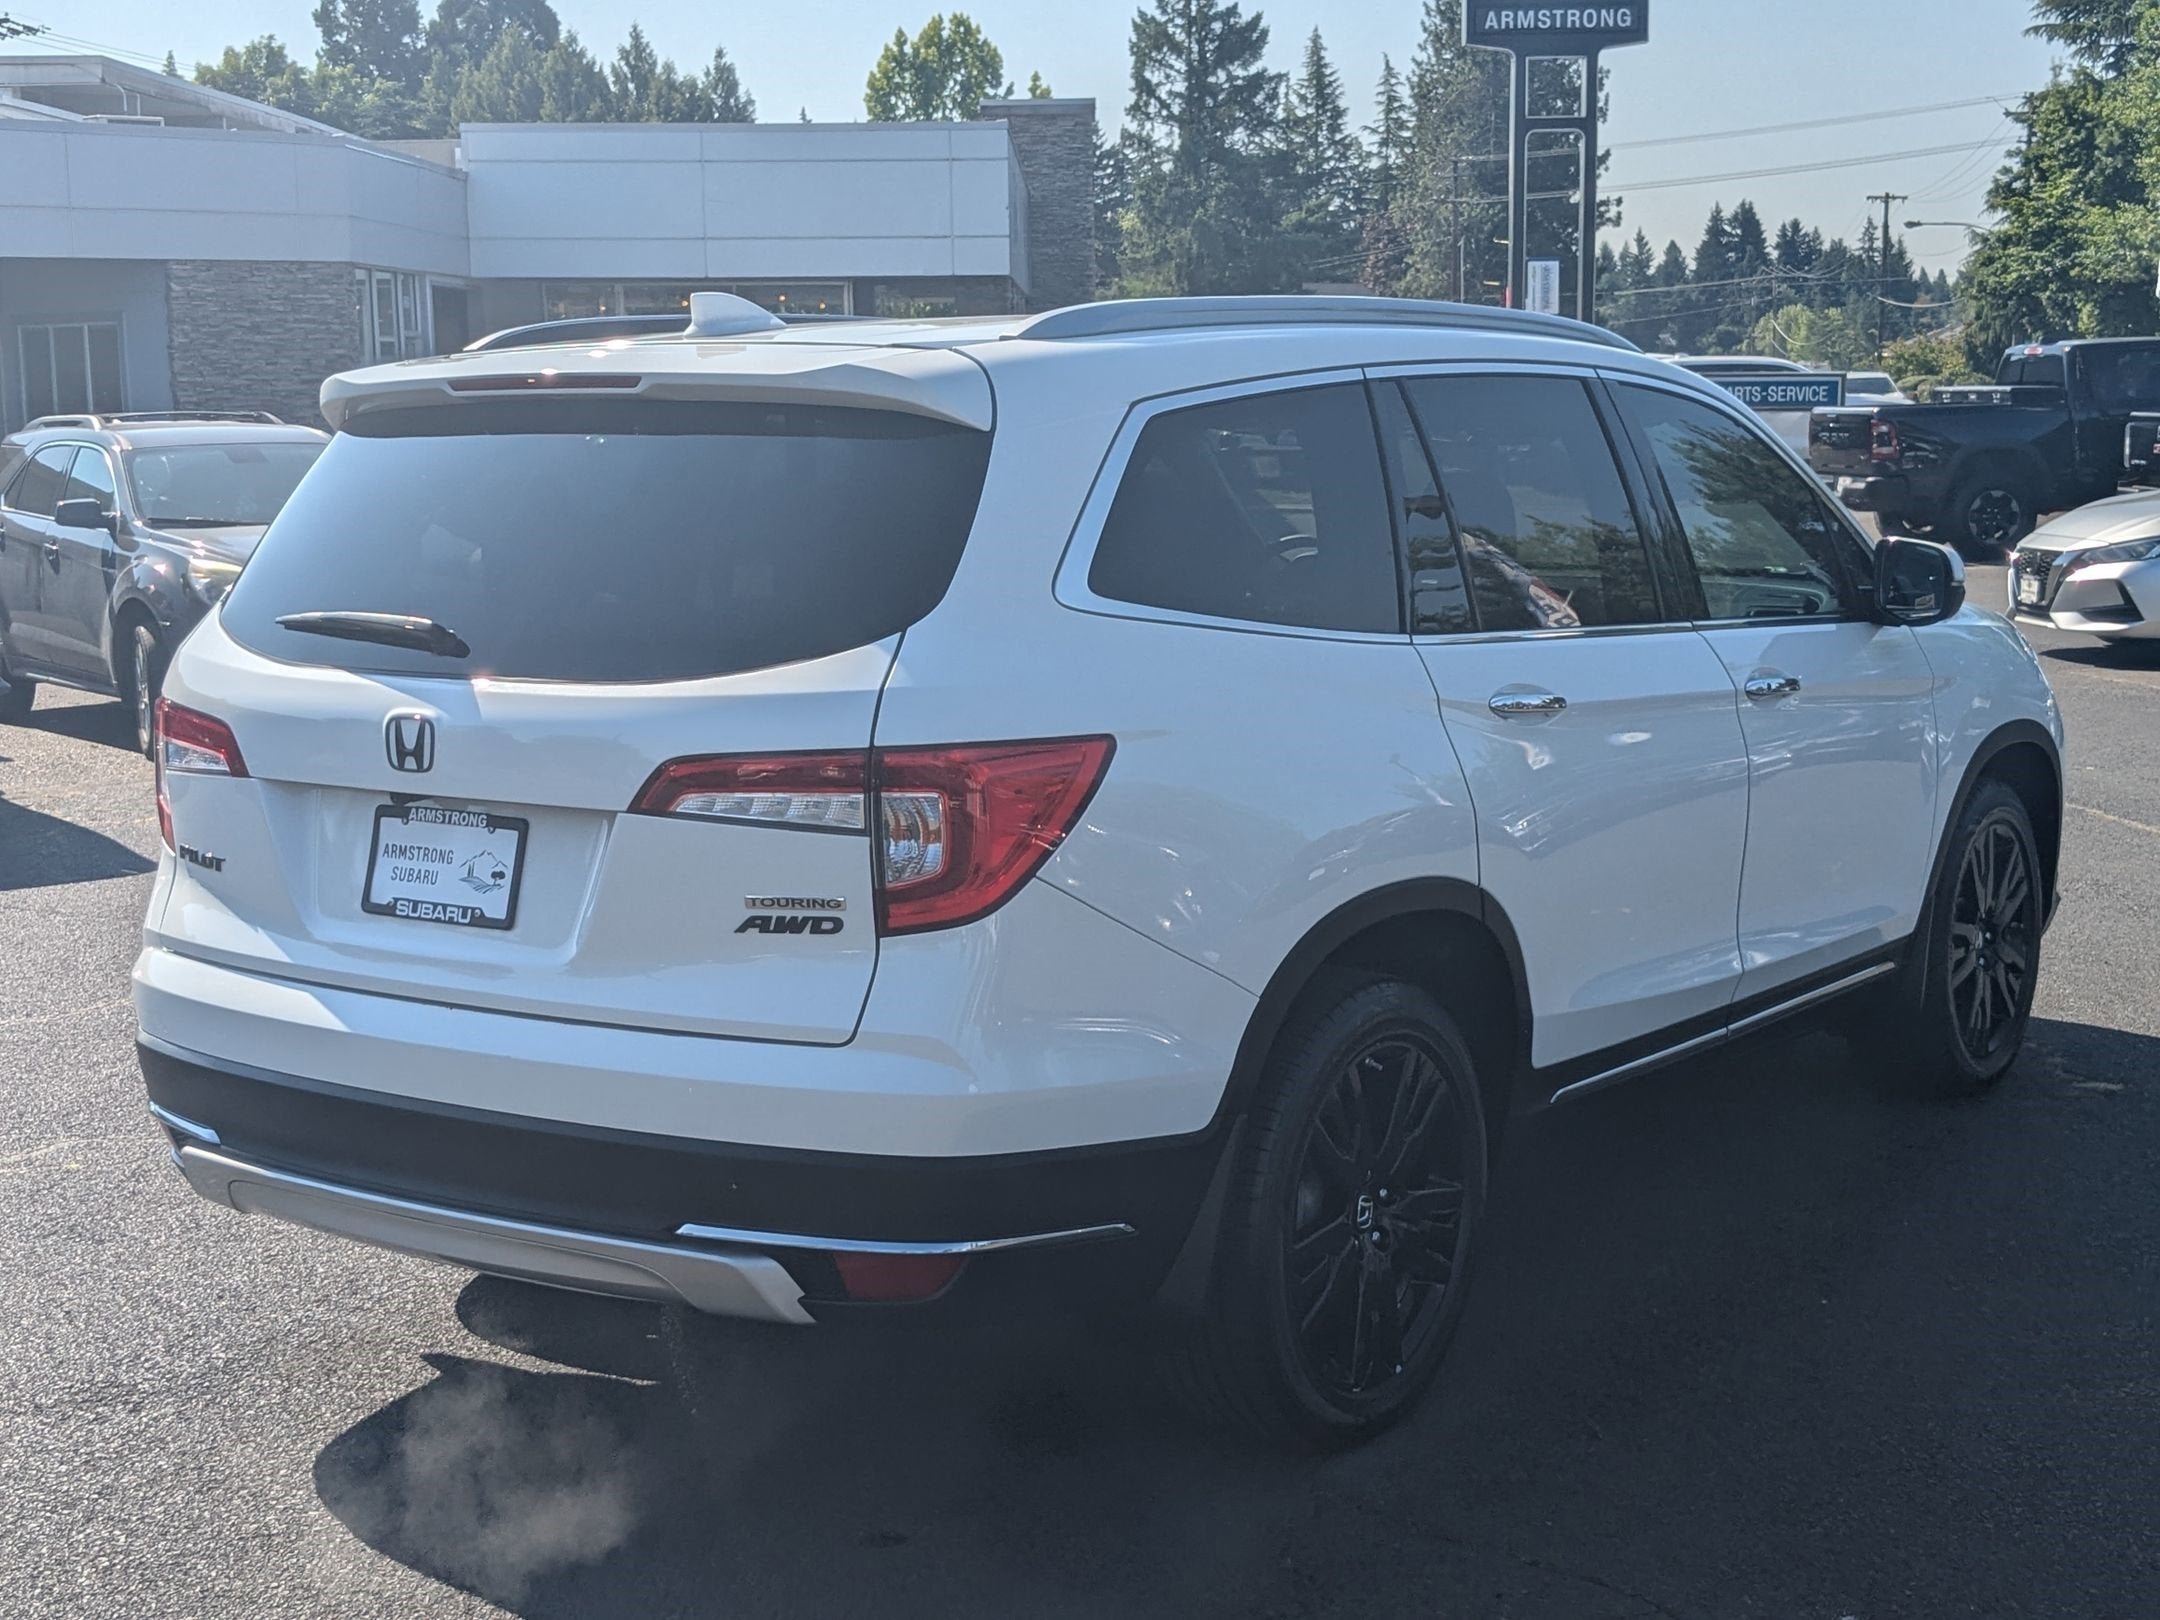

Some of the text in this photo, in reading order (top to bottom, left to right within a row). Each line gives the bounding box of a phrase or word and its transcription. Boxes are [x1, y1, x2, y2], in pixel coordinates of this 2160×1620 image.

[1484, 8, 1632, 29] ARMSTRONG
[1726, 385, 1829, 402] ARTS-SERVICE
[408, 807, 488, 828] ARMSTRONG
[382, 843, 454, 865] ARMSTRONG
[391, 866, 439, 886] SUBARU
[395, 900, 472, 924] SUBARU
[747, 897, 842, 909] TOURING
[733, 915, 844, 934] AWD
